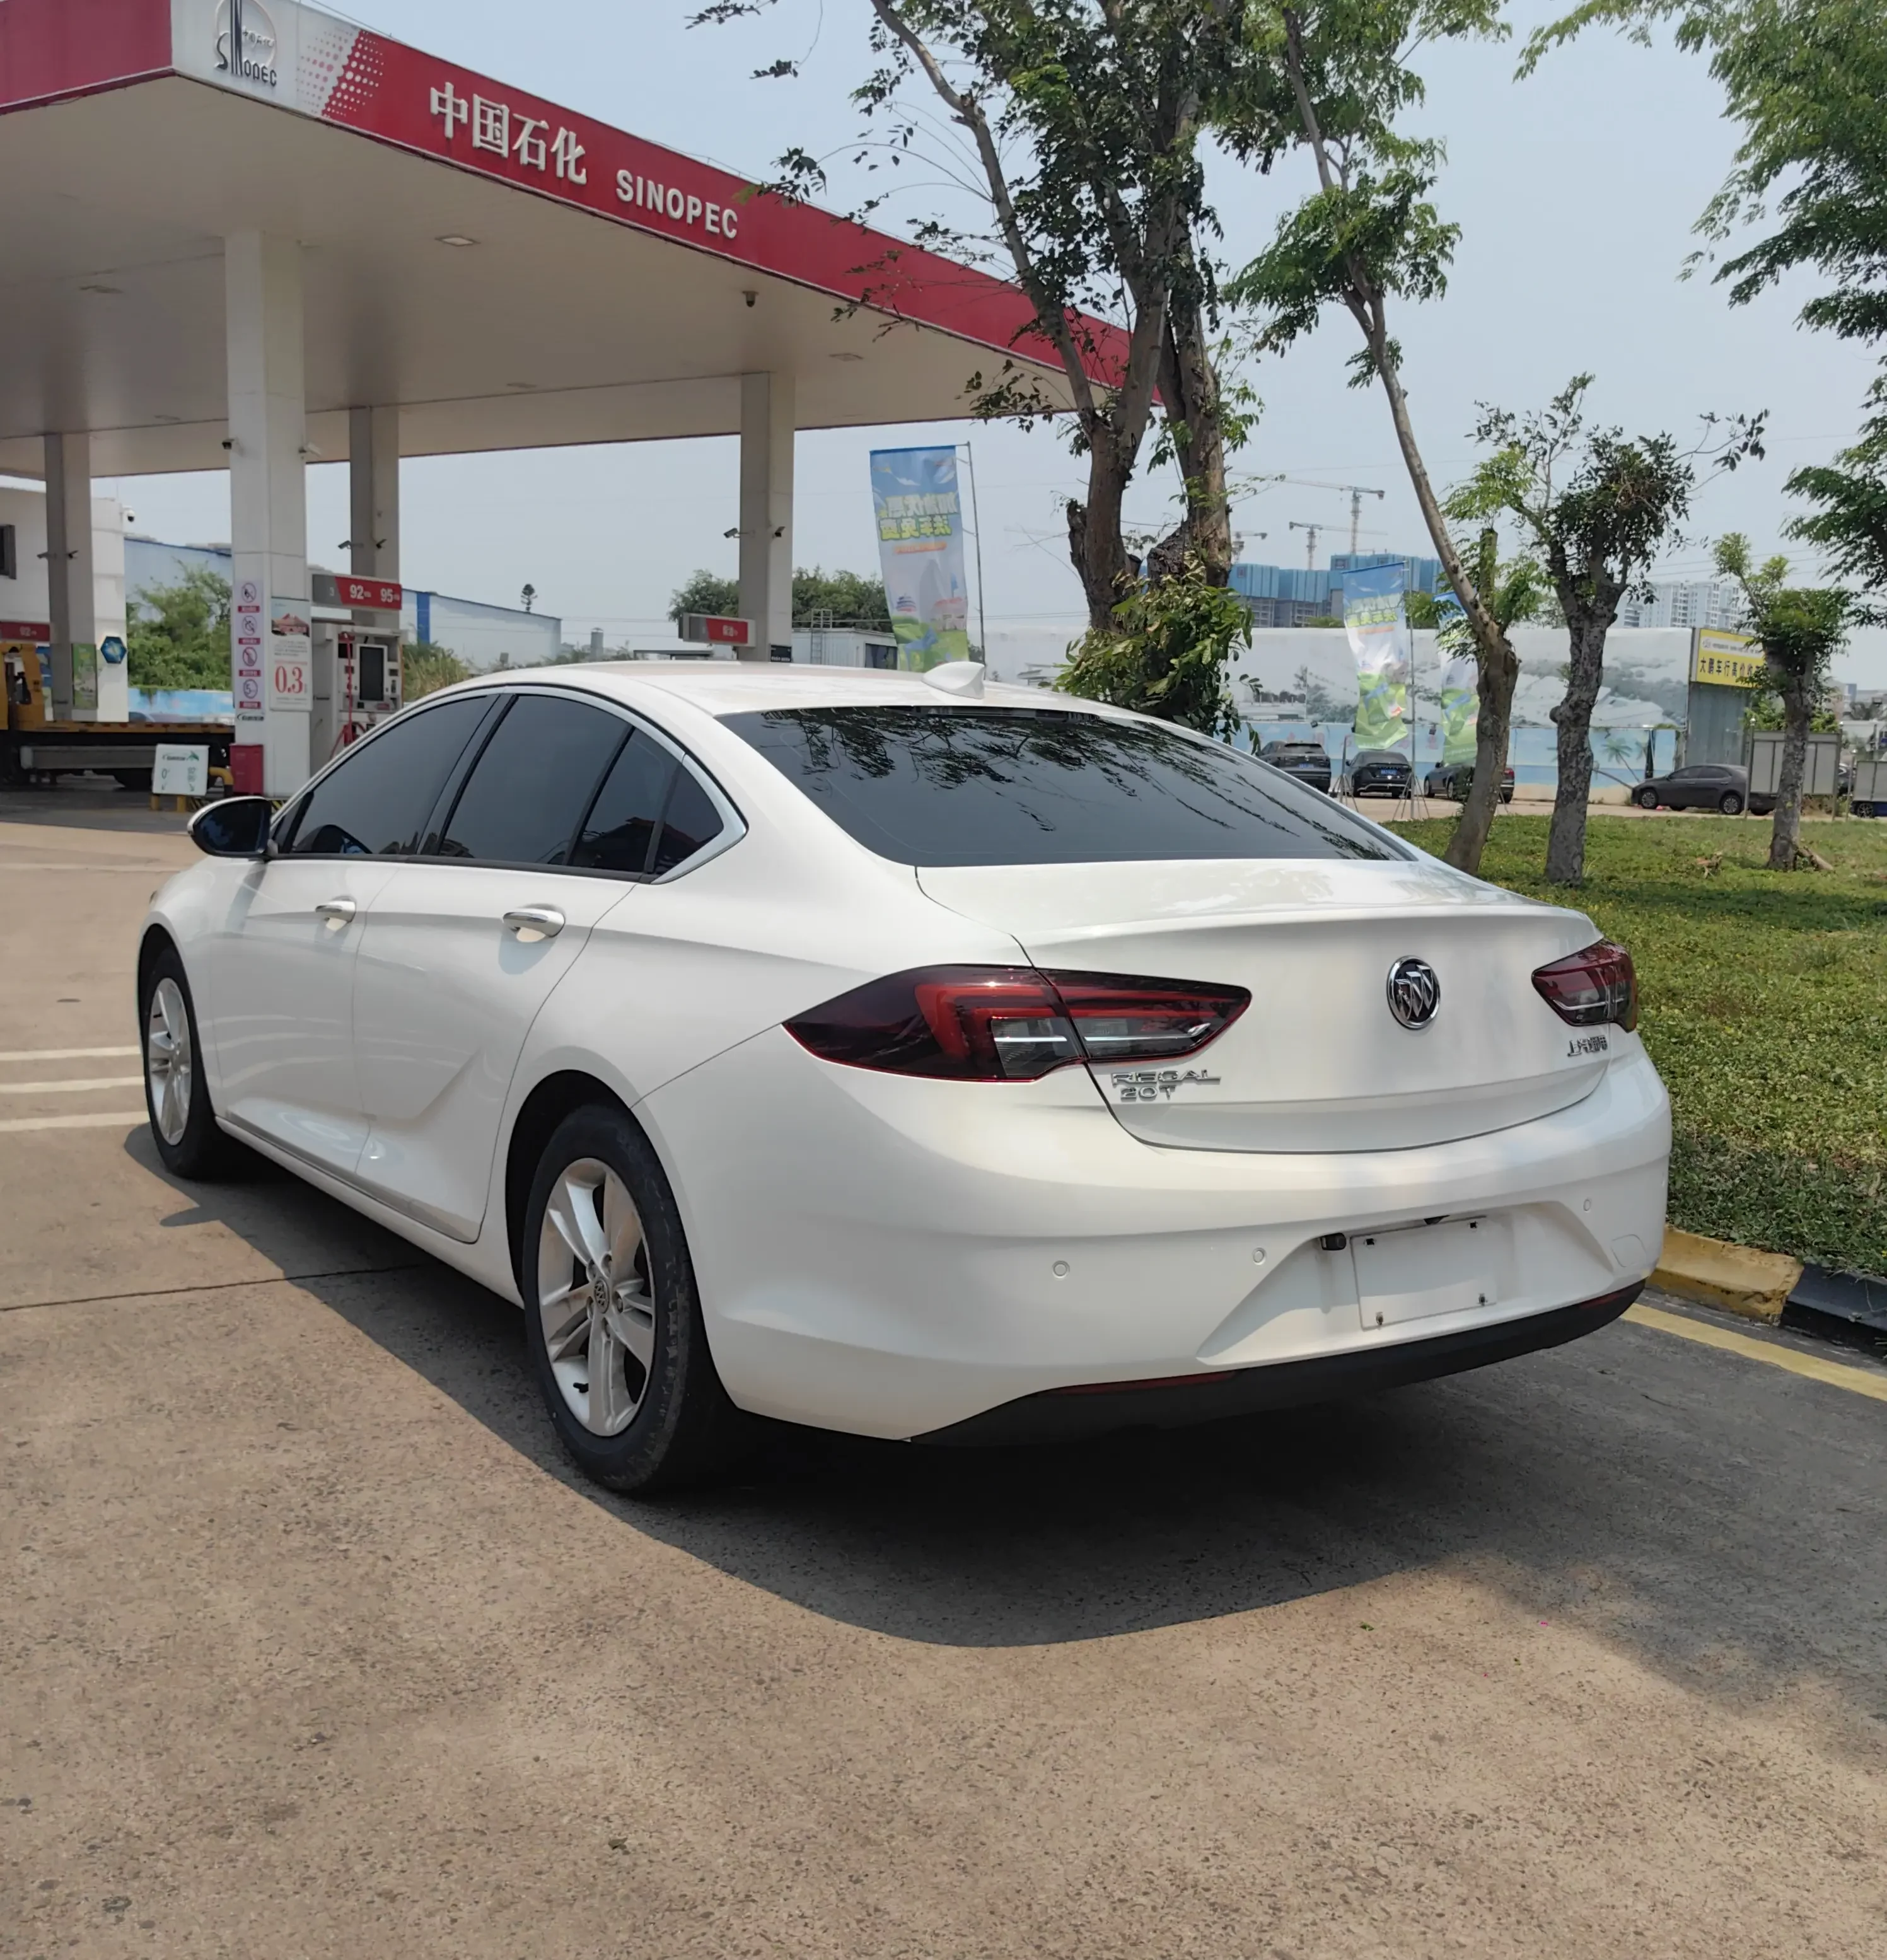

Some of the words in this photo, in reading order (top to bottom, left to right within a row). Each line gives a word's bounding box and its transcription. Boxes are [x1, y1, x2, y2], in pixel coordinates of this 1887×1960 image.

[430, 81, 587, 185] 中国石化
[615, 169, 738, 239] SINOPEC
[350, 584, 364, 600] 92
[380, 588, 393, 603] 95
[275, 666, 303, 693] 0.3
[1111, 1070, 1221, 1088] REGAL
[1120, 1085, 1176, 1102] 20T
